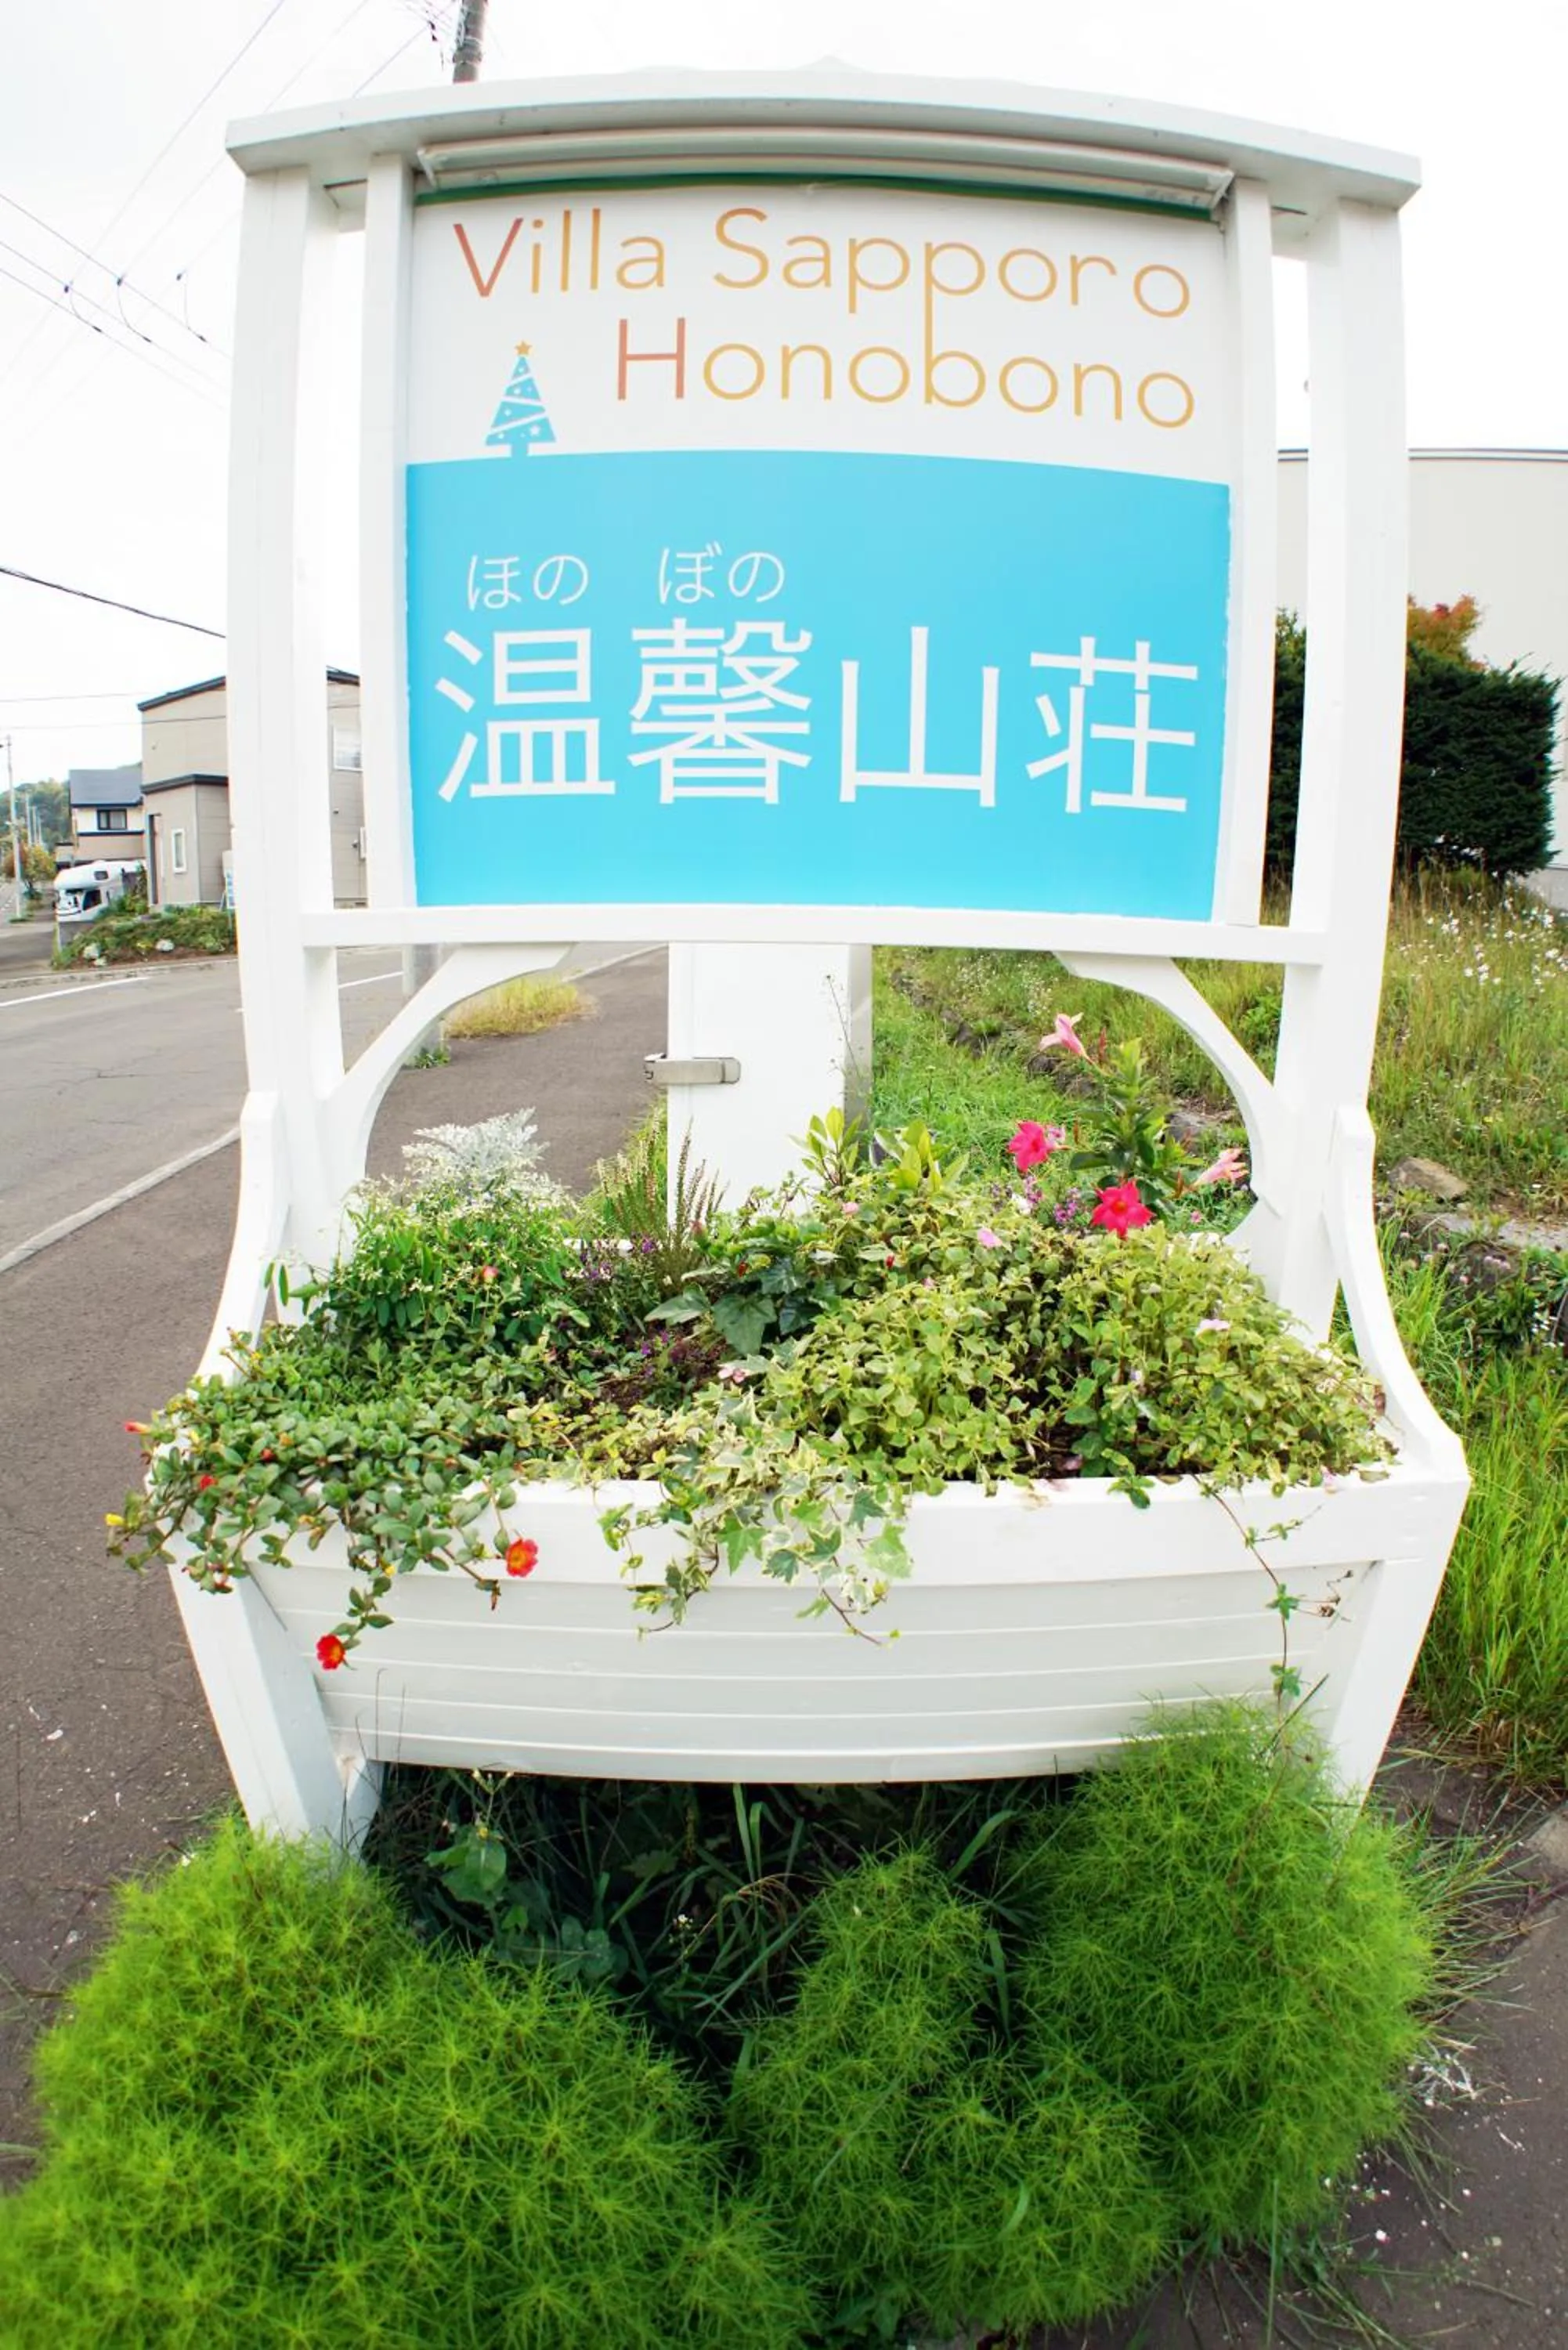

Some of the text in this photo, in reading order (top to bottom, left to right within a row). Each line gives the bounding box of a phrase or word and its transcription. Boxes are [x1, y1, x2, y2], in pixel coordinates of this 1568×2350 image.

[452, 207, 1191, 318] Villa Sapporo
[616, 316, 1195, 428] Honobono
[468, 541, 786, 611] ほの ぼの
[435, 616, 1199, 813] 温馨山荘
